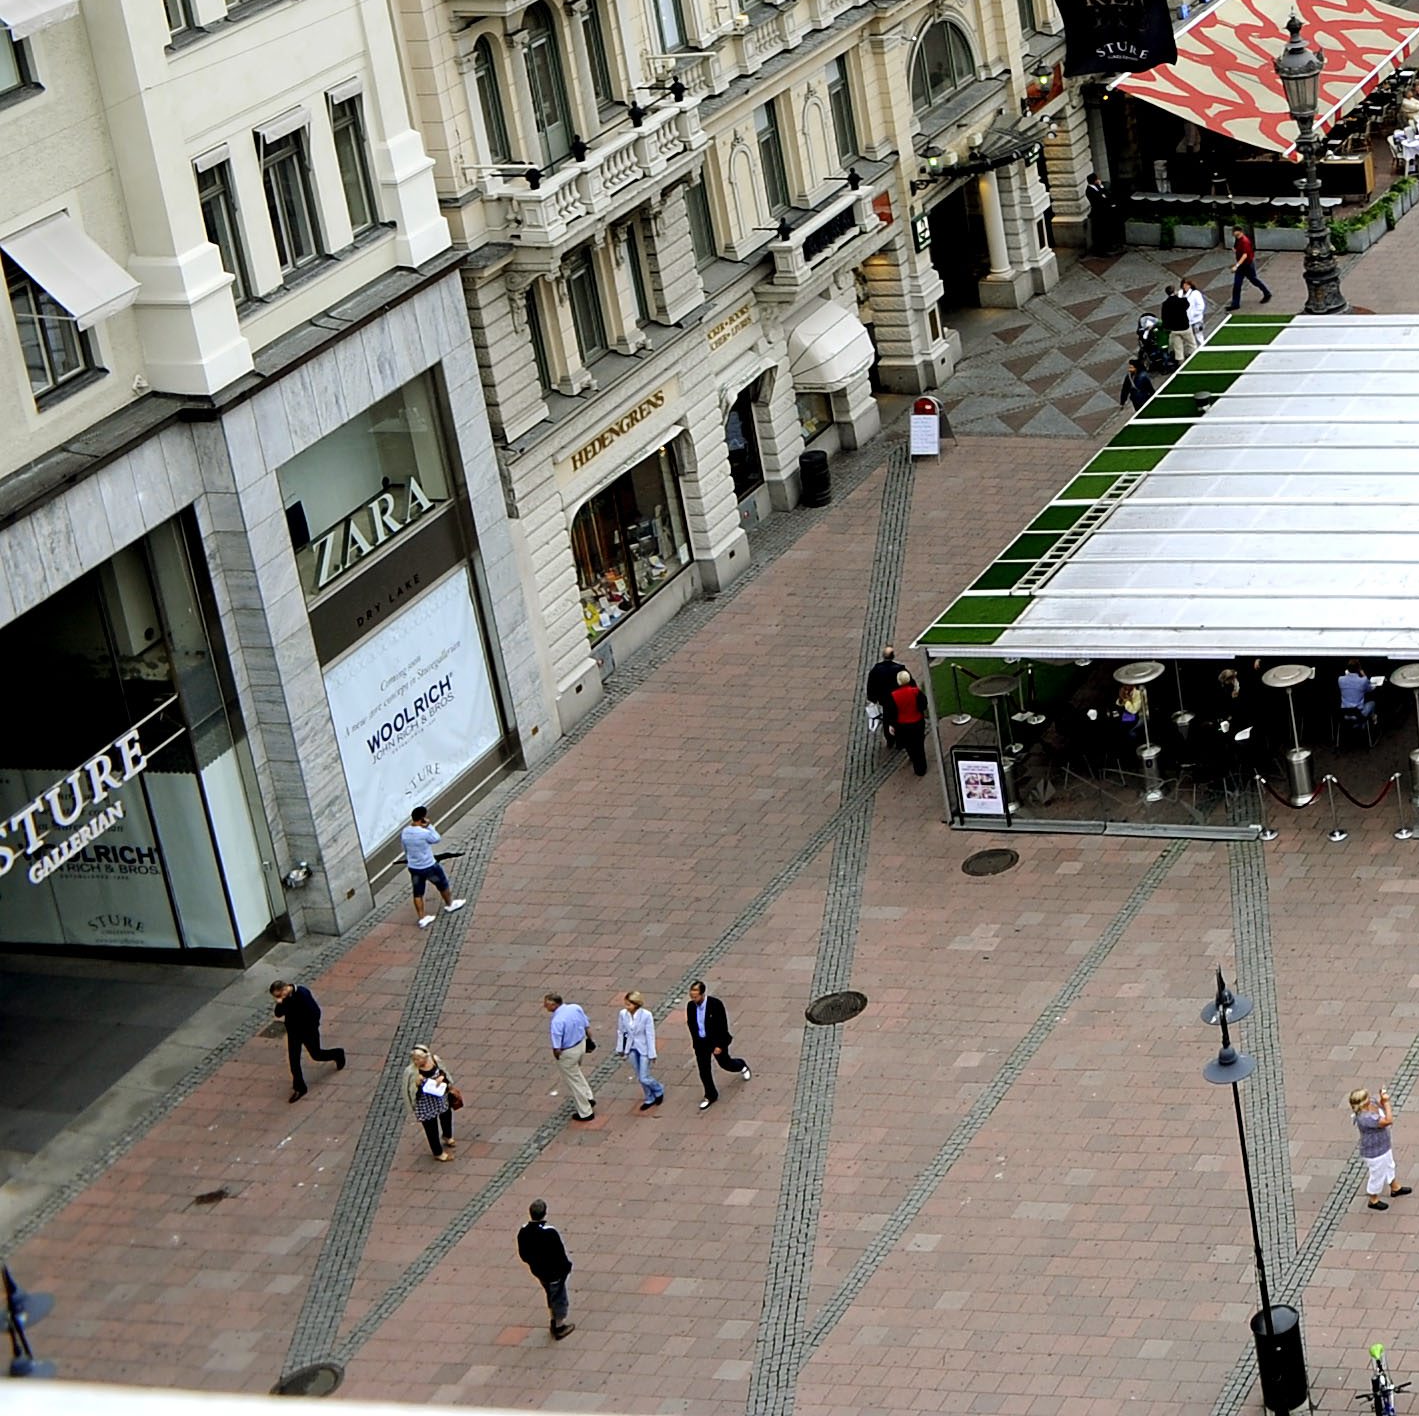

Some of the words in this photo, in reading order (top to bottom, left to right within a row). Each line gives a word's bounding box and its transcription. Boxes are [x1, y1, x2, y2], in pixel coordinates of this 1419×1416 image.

[1095, 41, 1149, 60] STURE
[571, 390, 665, 472] HEDENGRENS
[312, 476, 434, 588] ZARA
[356, 602, 381, 628] DRY
[388, 573, 420, 604] LAKE
[366, 673, 452, 754] WOOLRICH
[29, 800, 125, 885] GALLERIAN
[87, 914, 144, 933] STURE
